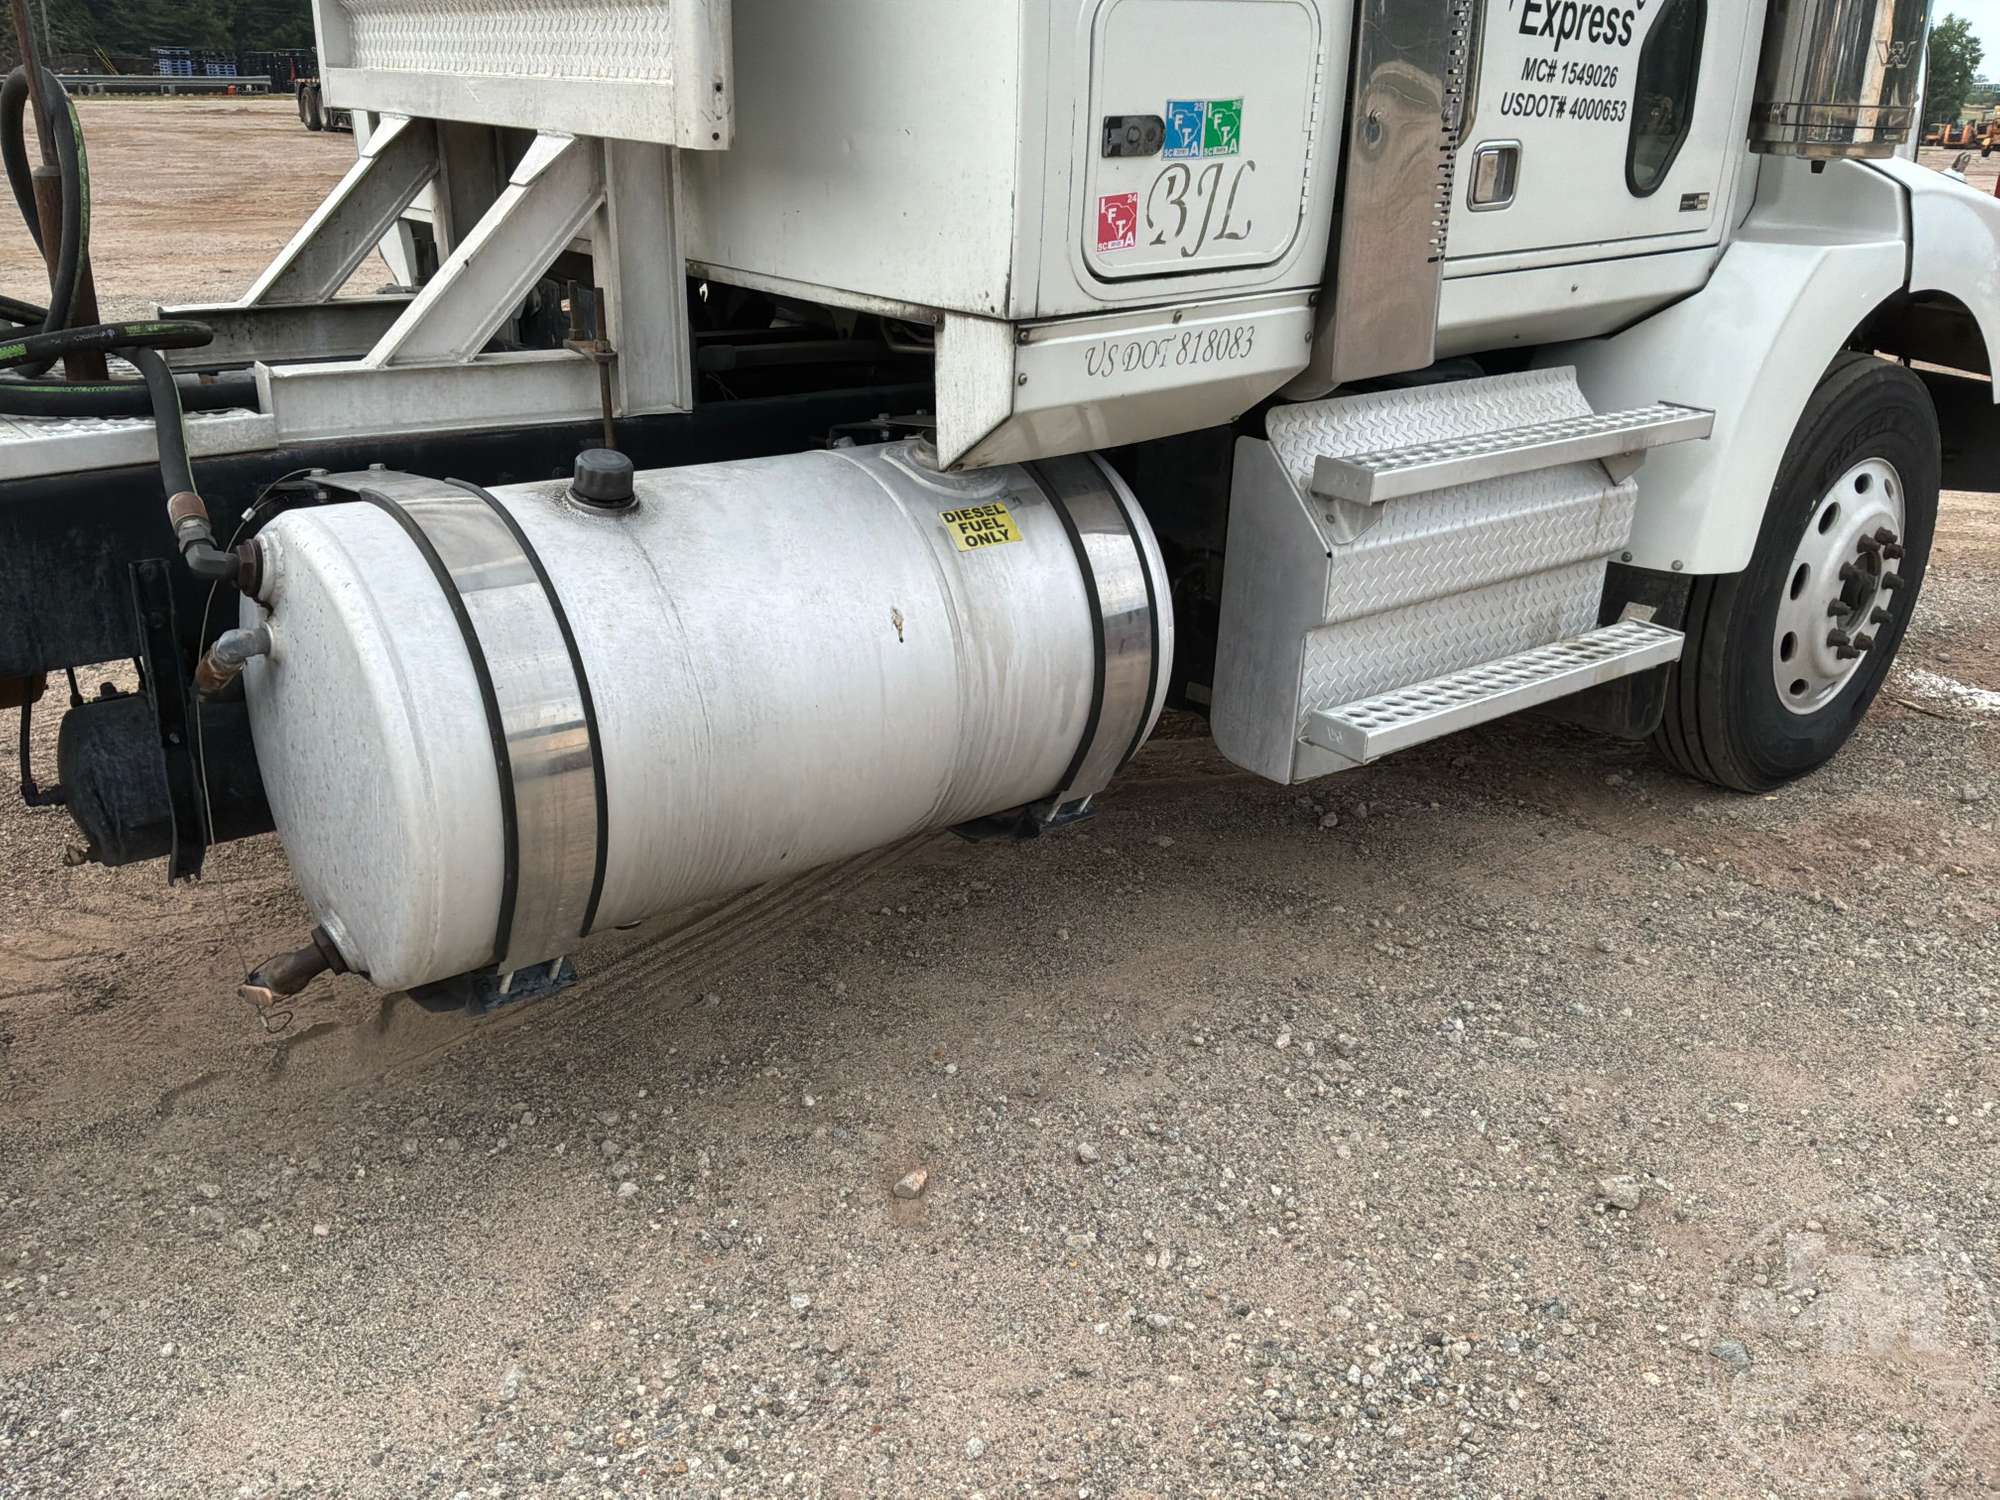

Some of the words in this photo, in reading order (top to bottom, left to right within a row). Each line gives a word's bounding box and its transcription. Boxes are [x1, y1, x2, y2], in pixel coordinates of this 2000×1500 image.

[1518, 0, 1635, 52] Express
[1521, 57, 1557, 83] MC#
[1561, 61, 1619, 89] 1549026
[1500, 92, 1566, 119] USDOT#
[1569, 96, 1627, 122] 4000653
[1146, 160, 1256, 258] BJL
[1175, 326, 1255, 366] 818083
[942, 504, 1006, 523] DIESEL
[958, 517, 1005, 535] FUEL
[964, 529, 1010, 547] ONLY
